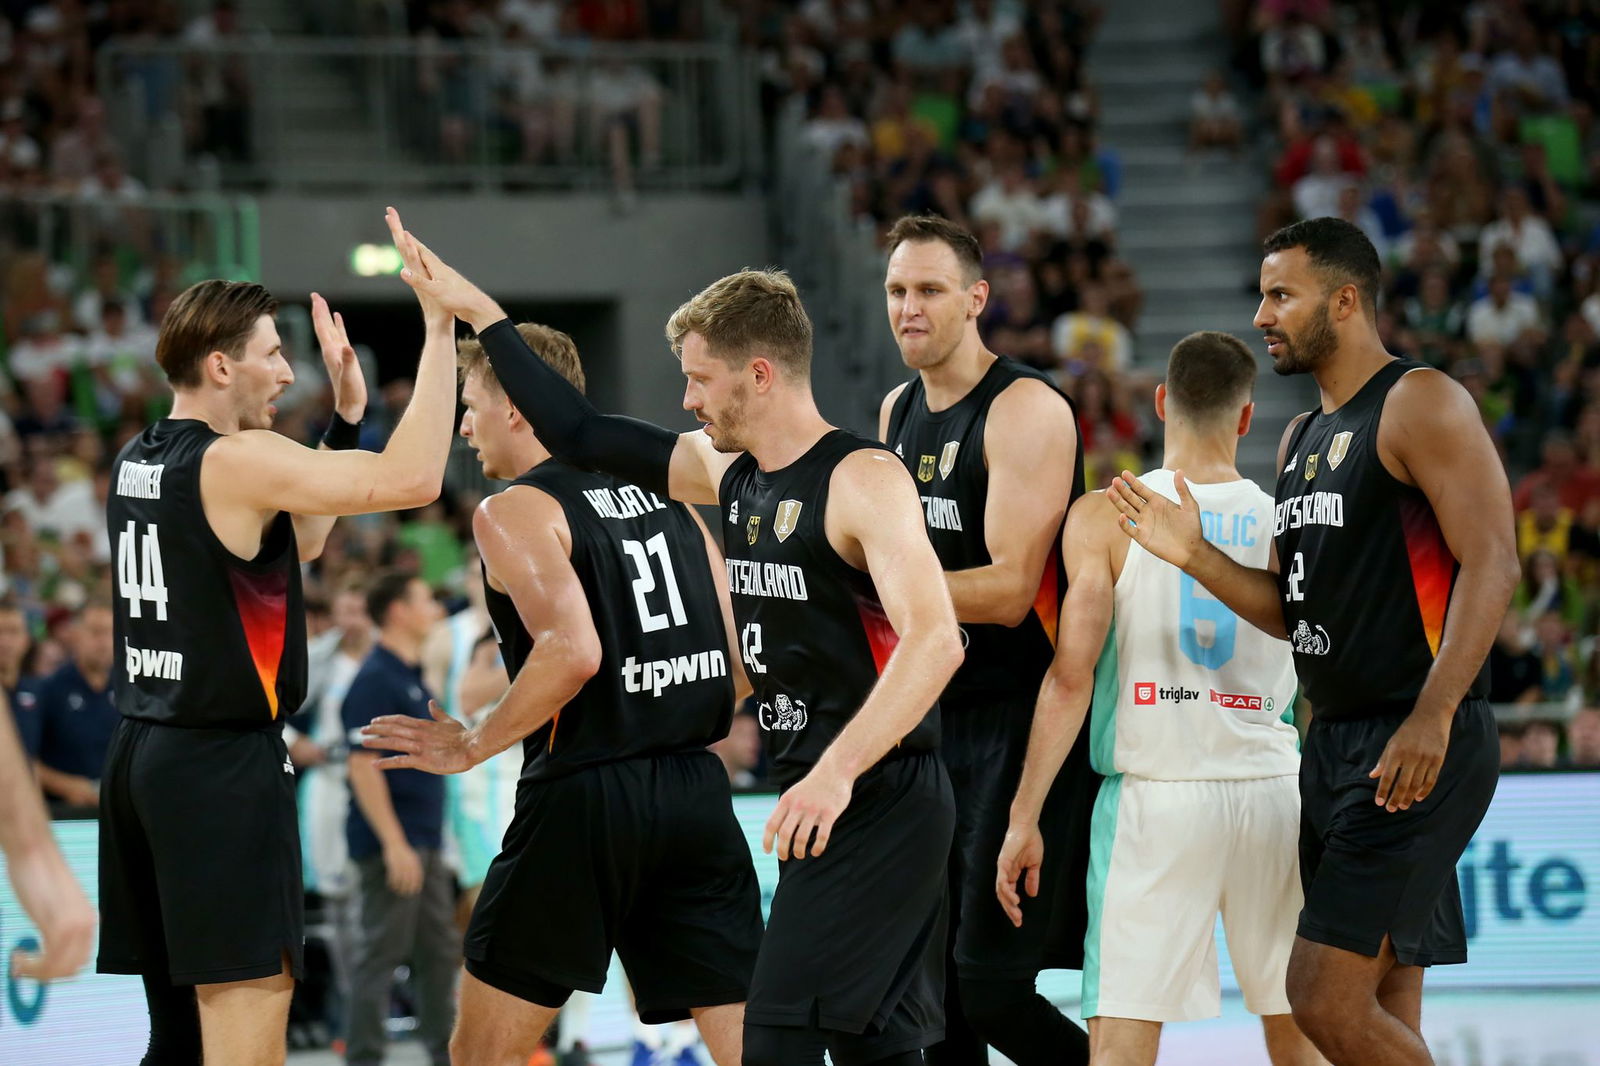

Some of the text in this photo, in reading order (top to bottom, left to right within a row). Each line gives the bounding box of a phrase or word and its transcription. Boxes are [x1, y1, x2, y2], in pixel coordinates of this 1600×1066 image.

[117, 520, 169, 621] 44
[621, 531, 689, 634] 21
[741, 622, 767, 674] 42
[1179, 567, 1238, 671] 6
[621, 650, 727, 698] tipwin
[1159, 686, 1200, 704] triglav
